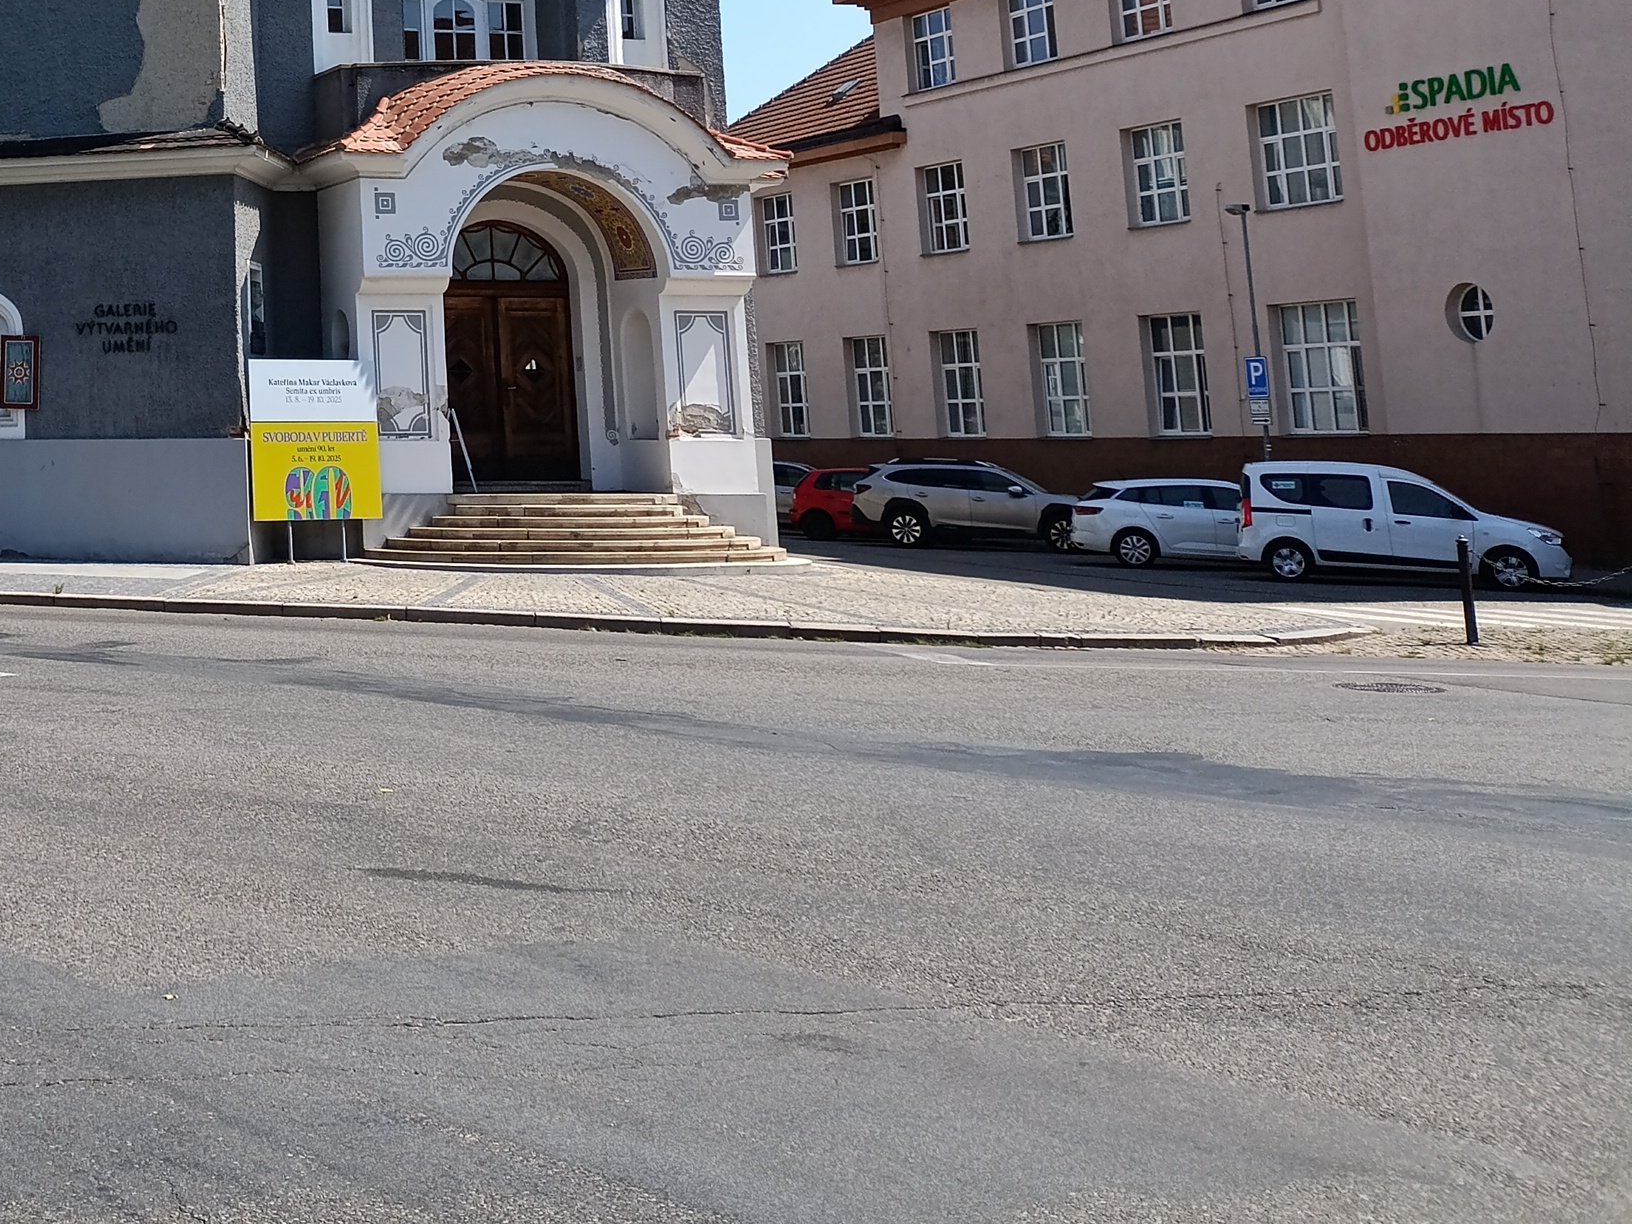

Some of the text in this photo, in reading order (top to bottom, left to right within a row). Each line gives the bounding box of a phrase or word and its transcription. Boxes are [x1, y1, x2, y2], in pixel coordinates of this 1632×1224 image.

[1410, 63, 1521, 110] SPADIA
[1364, 101, 1555, 152] ODBĚROVÉ MÍSTO
[94, 303, 157, 318] GALERIE
[75, 319, 178, 336] VÝTVARNÉHO
[102, 336, 152, 354] UMĚNÍ
[268, 378, 297, 386] Kateřina
[298, 378, 320, 386] Makar
[1249, 362, 1263, 385] P
[285, 387, 308, 395] Semita
[318, 387, 341, 395] umbris
[262, 429, 367, 443] SVOBODA V PUBERTĚ
